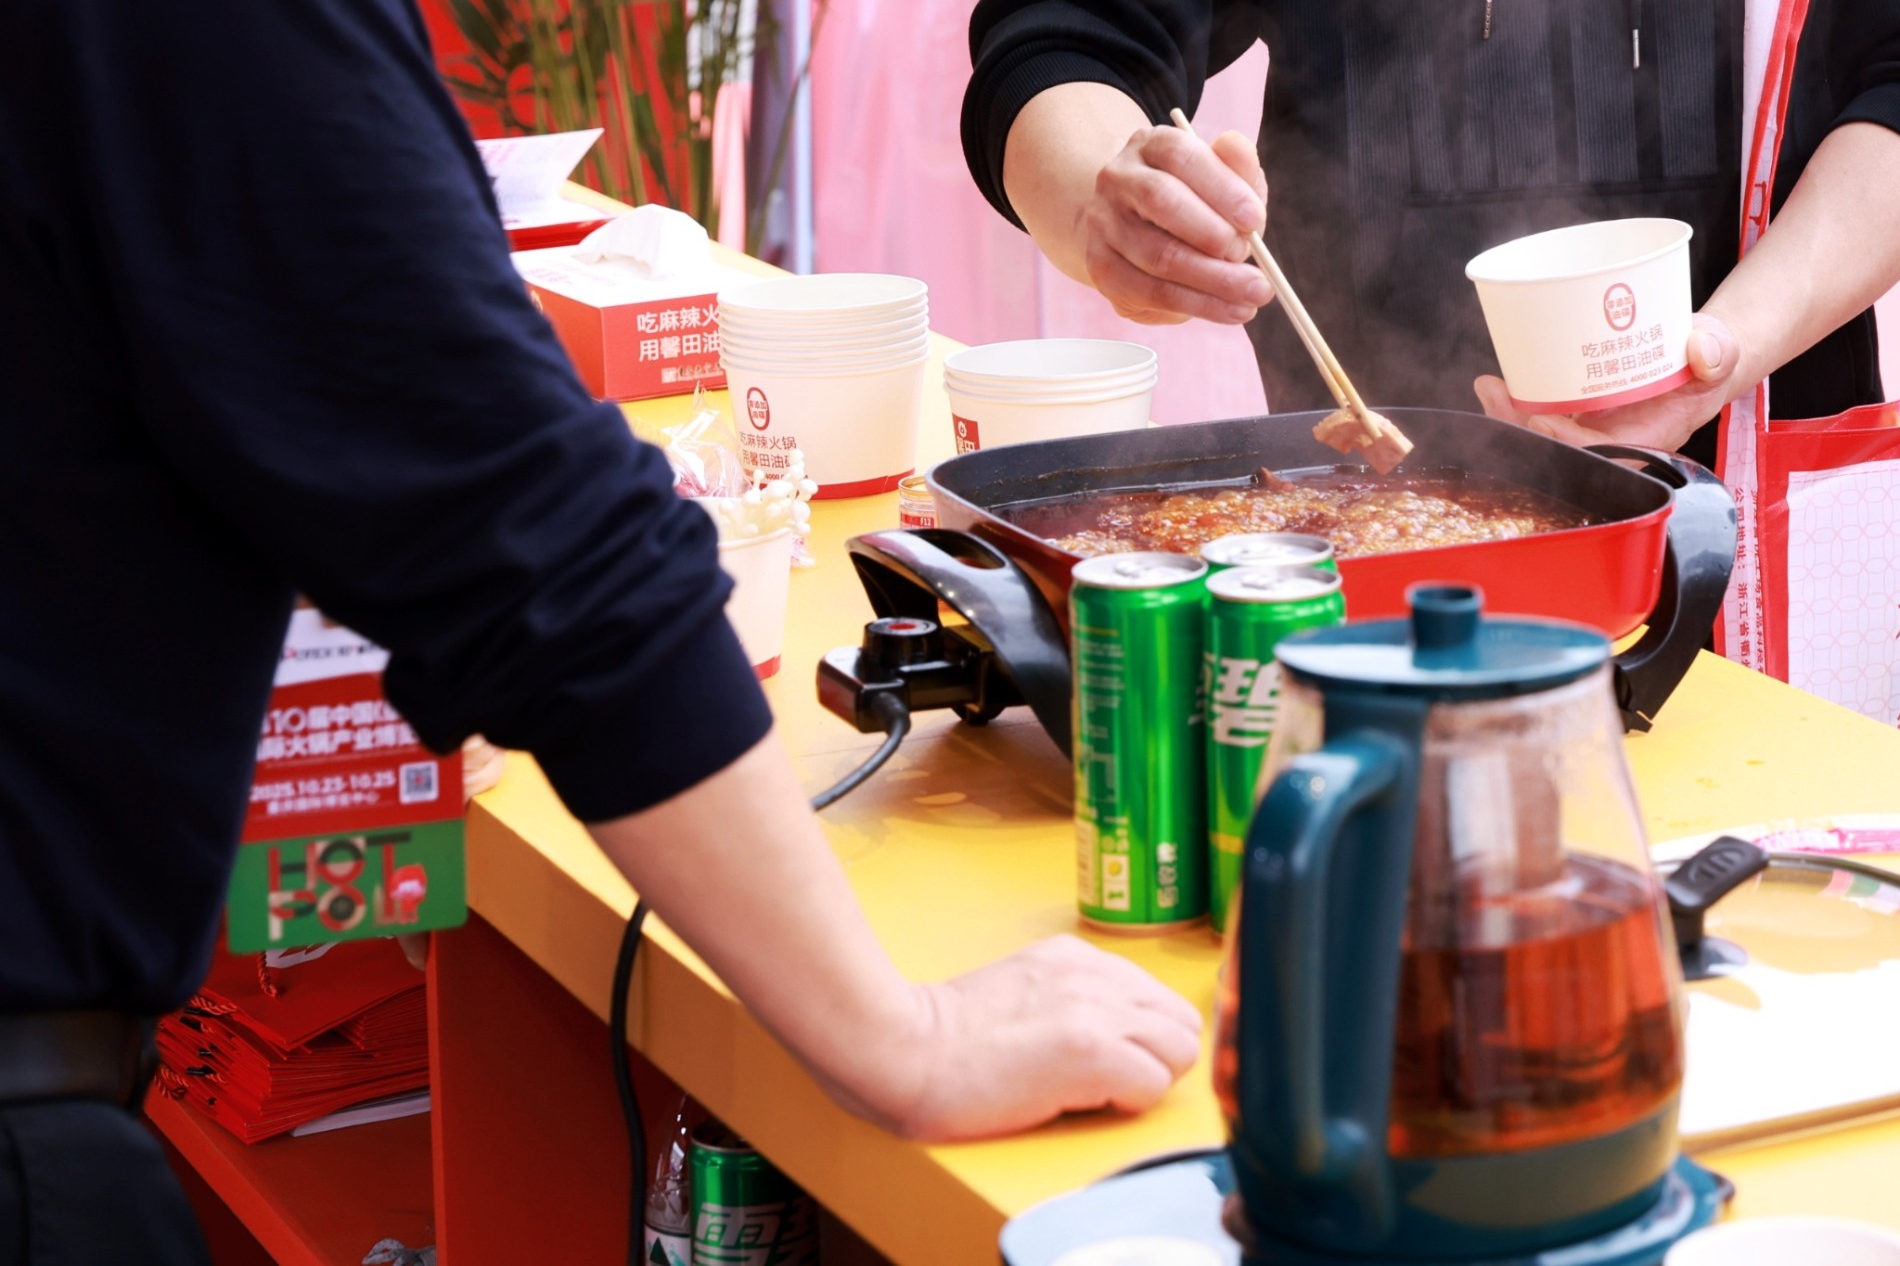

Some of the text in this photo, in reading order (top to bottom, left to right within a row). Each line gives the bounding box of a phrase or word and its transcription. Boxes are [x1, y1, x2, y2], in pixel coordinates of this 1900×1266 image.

[1581, 324, 1663, 358] 吃麻辣火锅
[1586, 344, 1665, 379] 用馨田油碟
[1630, 373, 1648, 383] 4000
